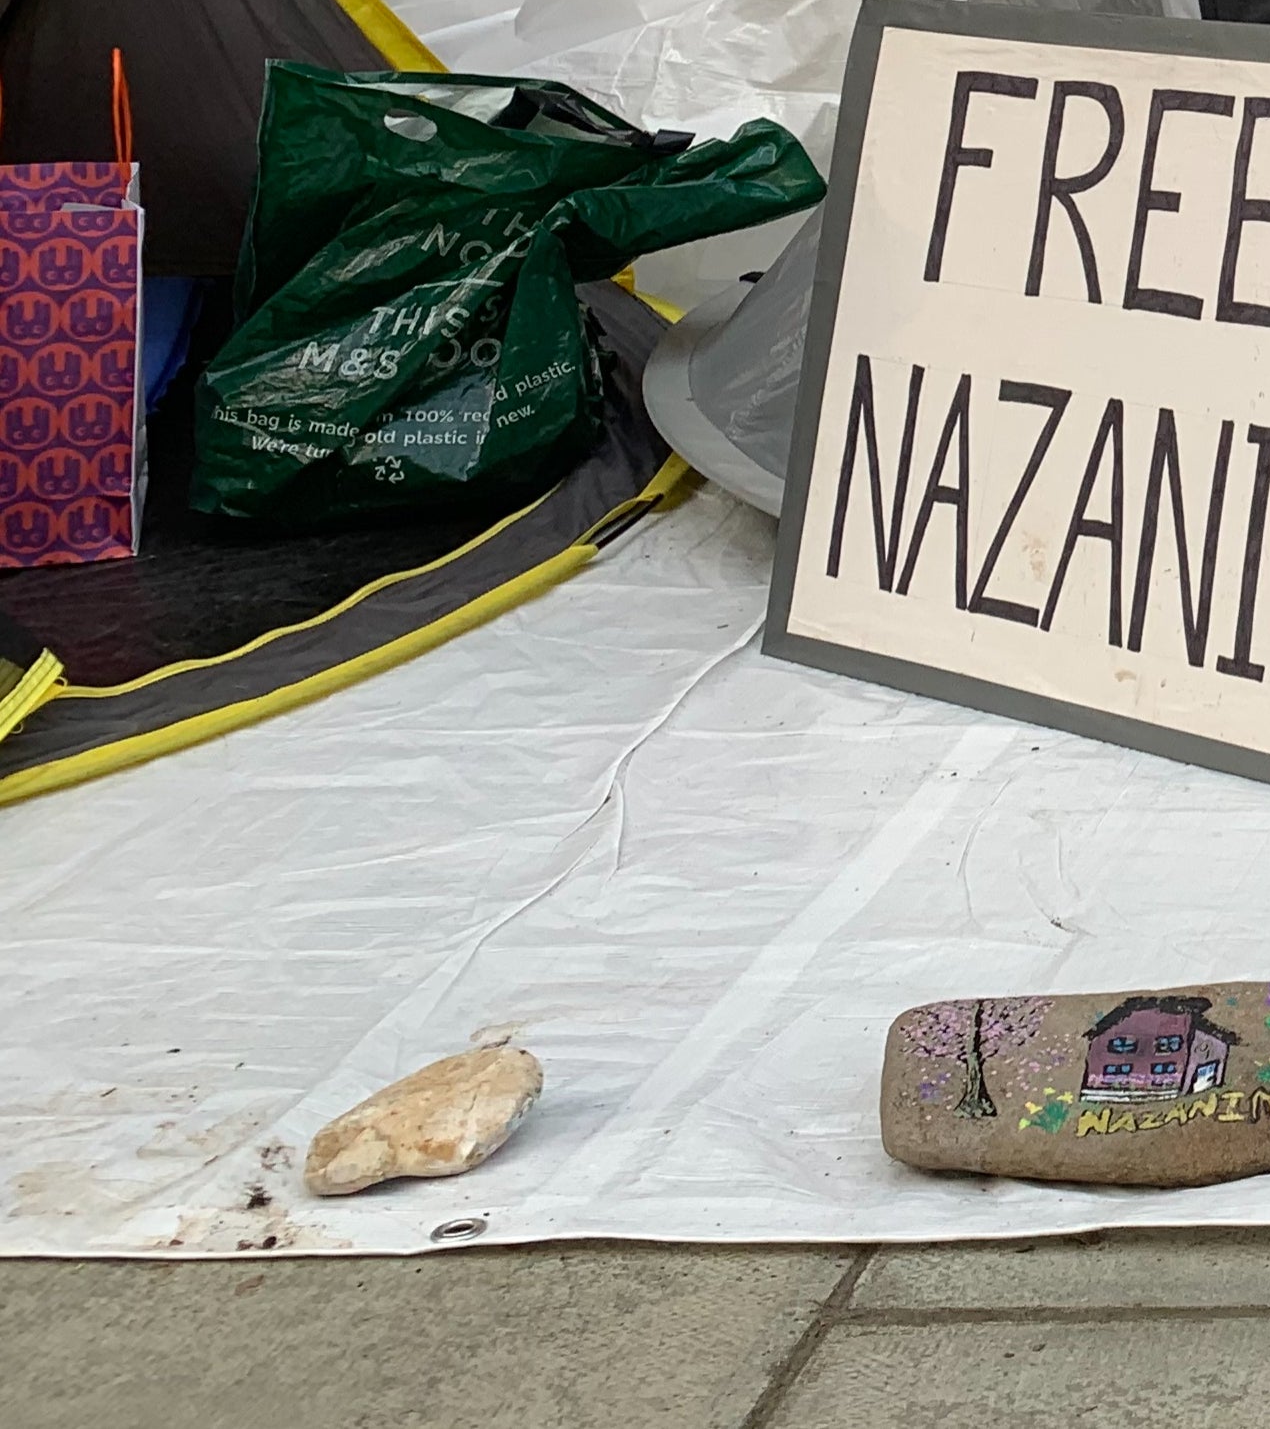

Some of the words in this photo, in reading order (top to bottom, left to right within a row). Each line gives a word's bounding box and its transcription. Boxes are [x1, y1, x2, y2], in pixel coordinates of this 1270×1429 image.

[366, 305, 470, 338] THIS
[300, 341, 400, 380] M&S
[211, 405, 239, 422] his
[247, 408, 280, 431] bag
[287, 413, 302, 431] is
[308, 420, 361, 439] made
[405, 409, 455, 423] 100%
[250, 434, 300, 456] We're
[304, 442, 334, 459] tur
[364, 429, 396, 445] old
[403, 429, 468, 446] plastic
